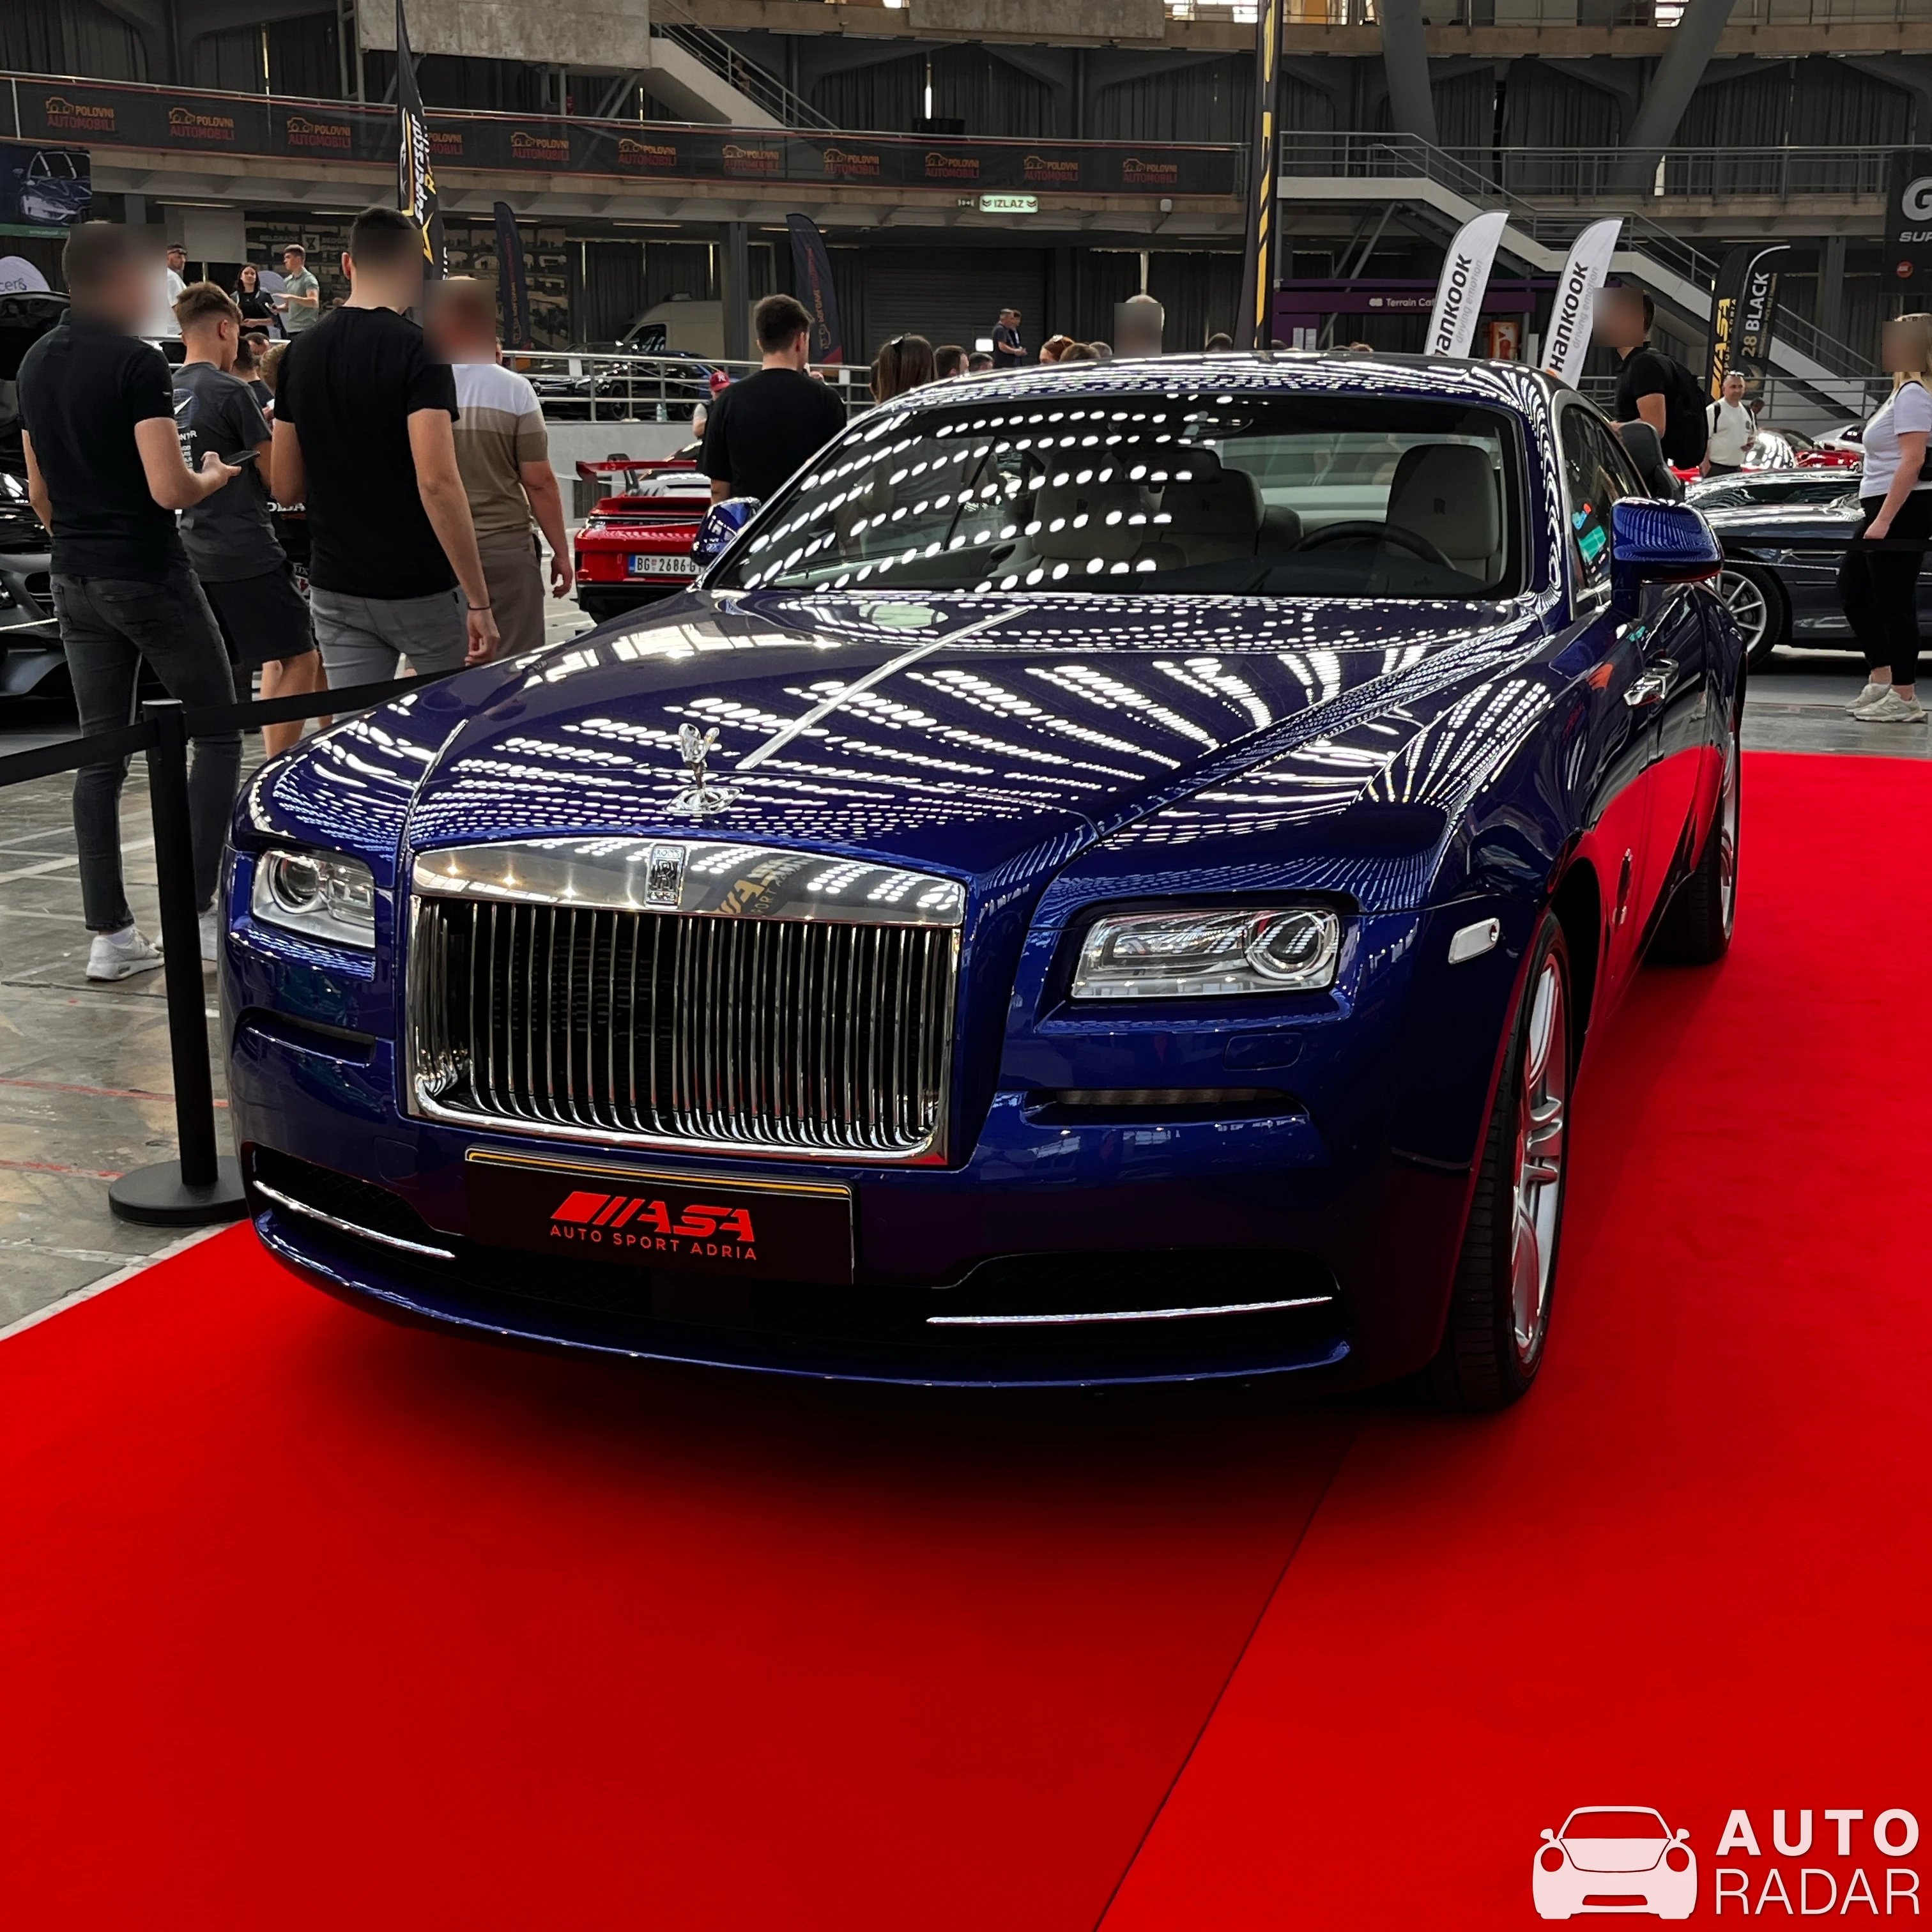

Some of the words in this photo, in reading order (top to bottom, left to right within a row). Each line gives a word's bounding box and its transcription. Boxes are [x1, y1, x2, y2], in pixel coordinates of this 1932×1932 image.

[75, 106, 114, 119] POLOVNI
[47, 116, 115, 131] AUTOMOBILI
[196, 116, 234, 128] POLOVNI
[171, 126, 234, 141] AUTOMOBILI
[314, 125, 351, 137] POLOVNI
[289, 134, 351, 149] AUTOMOBILI
[535, 139, 569, 151] POLOVNI
[430, 142, 463, 155] MOBILI
[643, 145, 676, 155] POLOVNI
[847, 154, 879, 164] POLOVNI
[947, 158, 979, 168] POLOVNI
[1046, 161, 1078, 171] POLOVNI
[1146, 164, 1177, 173] POLOVNI
[994, 199, 1023, 208] IZLAZ
[1386, 298, 1416, 307] Terrain
[1745, 272, 1770, 331] BLACK
[1741, 335, 1757, 358] 28
[637, 558, 650, 571] BG
[551, 1225, 602, 1242] AUTO
[613, 1233, 679, 1252] SPORT
[691, 1243, 757, 1261] ADRIA
